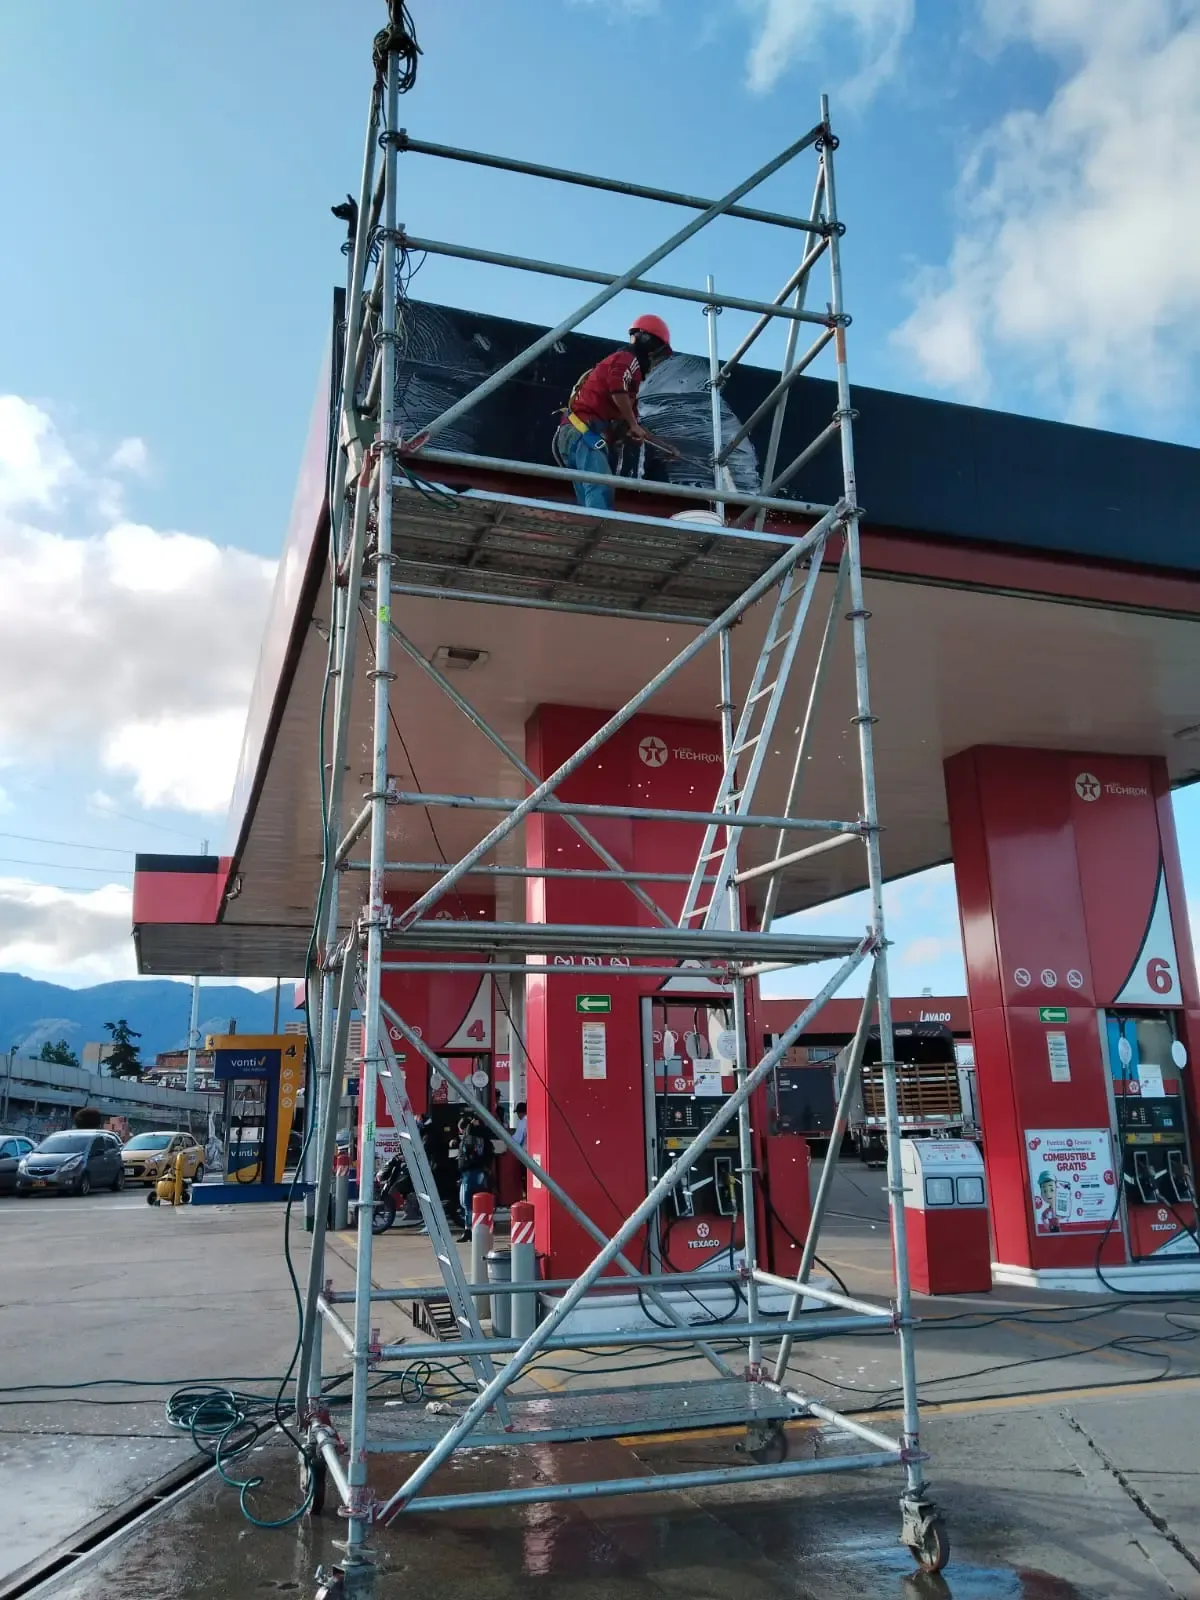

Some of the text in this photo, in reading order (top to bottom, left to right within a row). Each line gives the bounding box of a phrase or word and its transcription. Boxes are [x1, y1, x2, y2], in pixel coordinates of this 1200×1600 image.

[1146, 957, 1173, 994] 6
[466, 1019, 486, 1041] 4
[208, 1037, 215, 1047] 4
[285, 1044, 297, 1057] 4
[231, 1057, 257, 1067] vanti
[1042, 1152, 1096, 1162] COMBUSTIBLE
[1057, 1162, 1087, 1171] GRATIS
[687, 1240, 720, 1248] TEXACO
